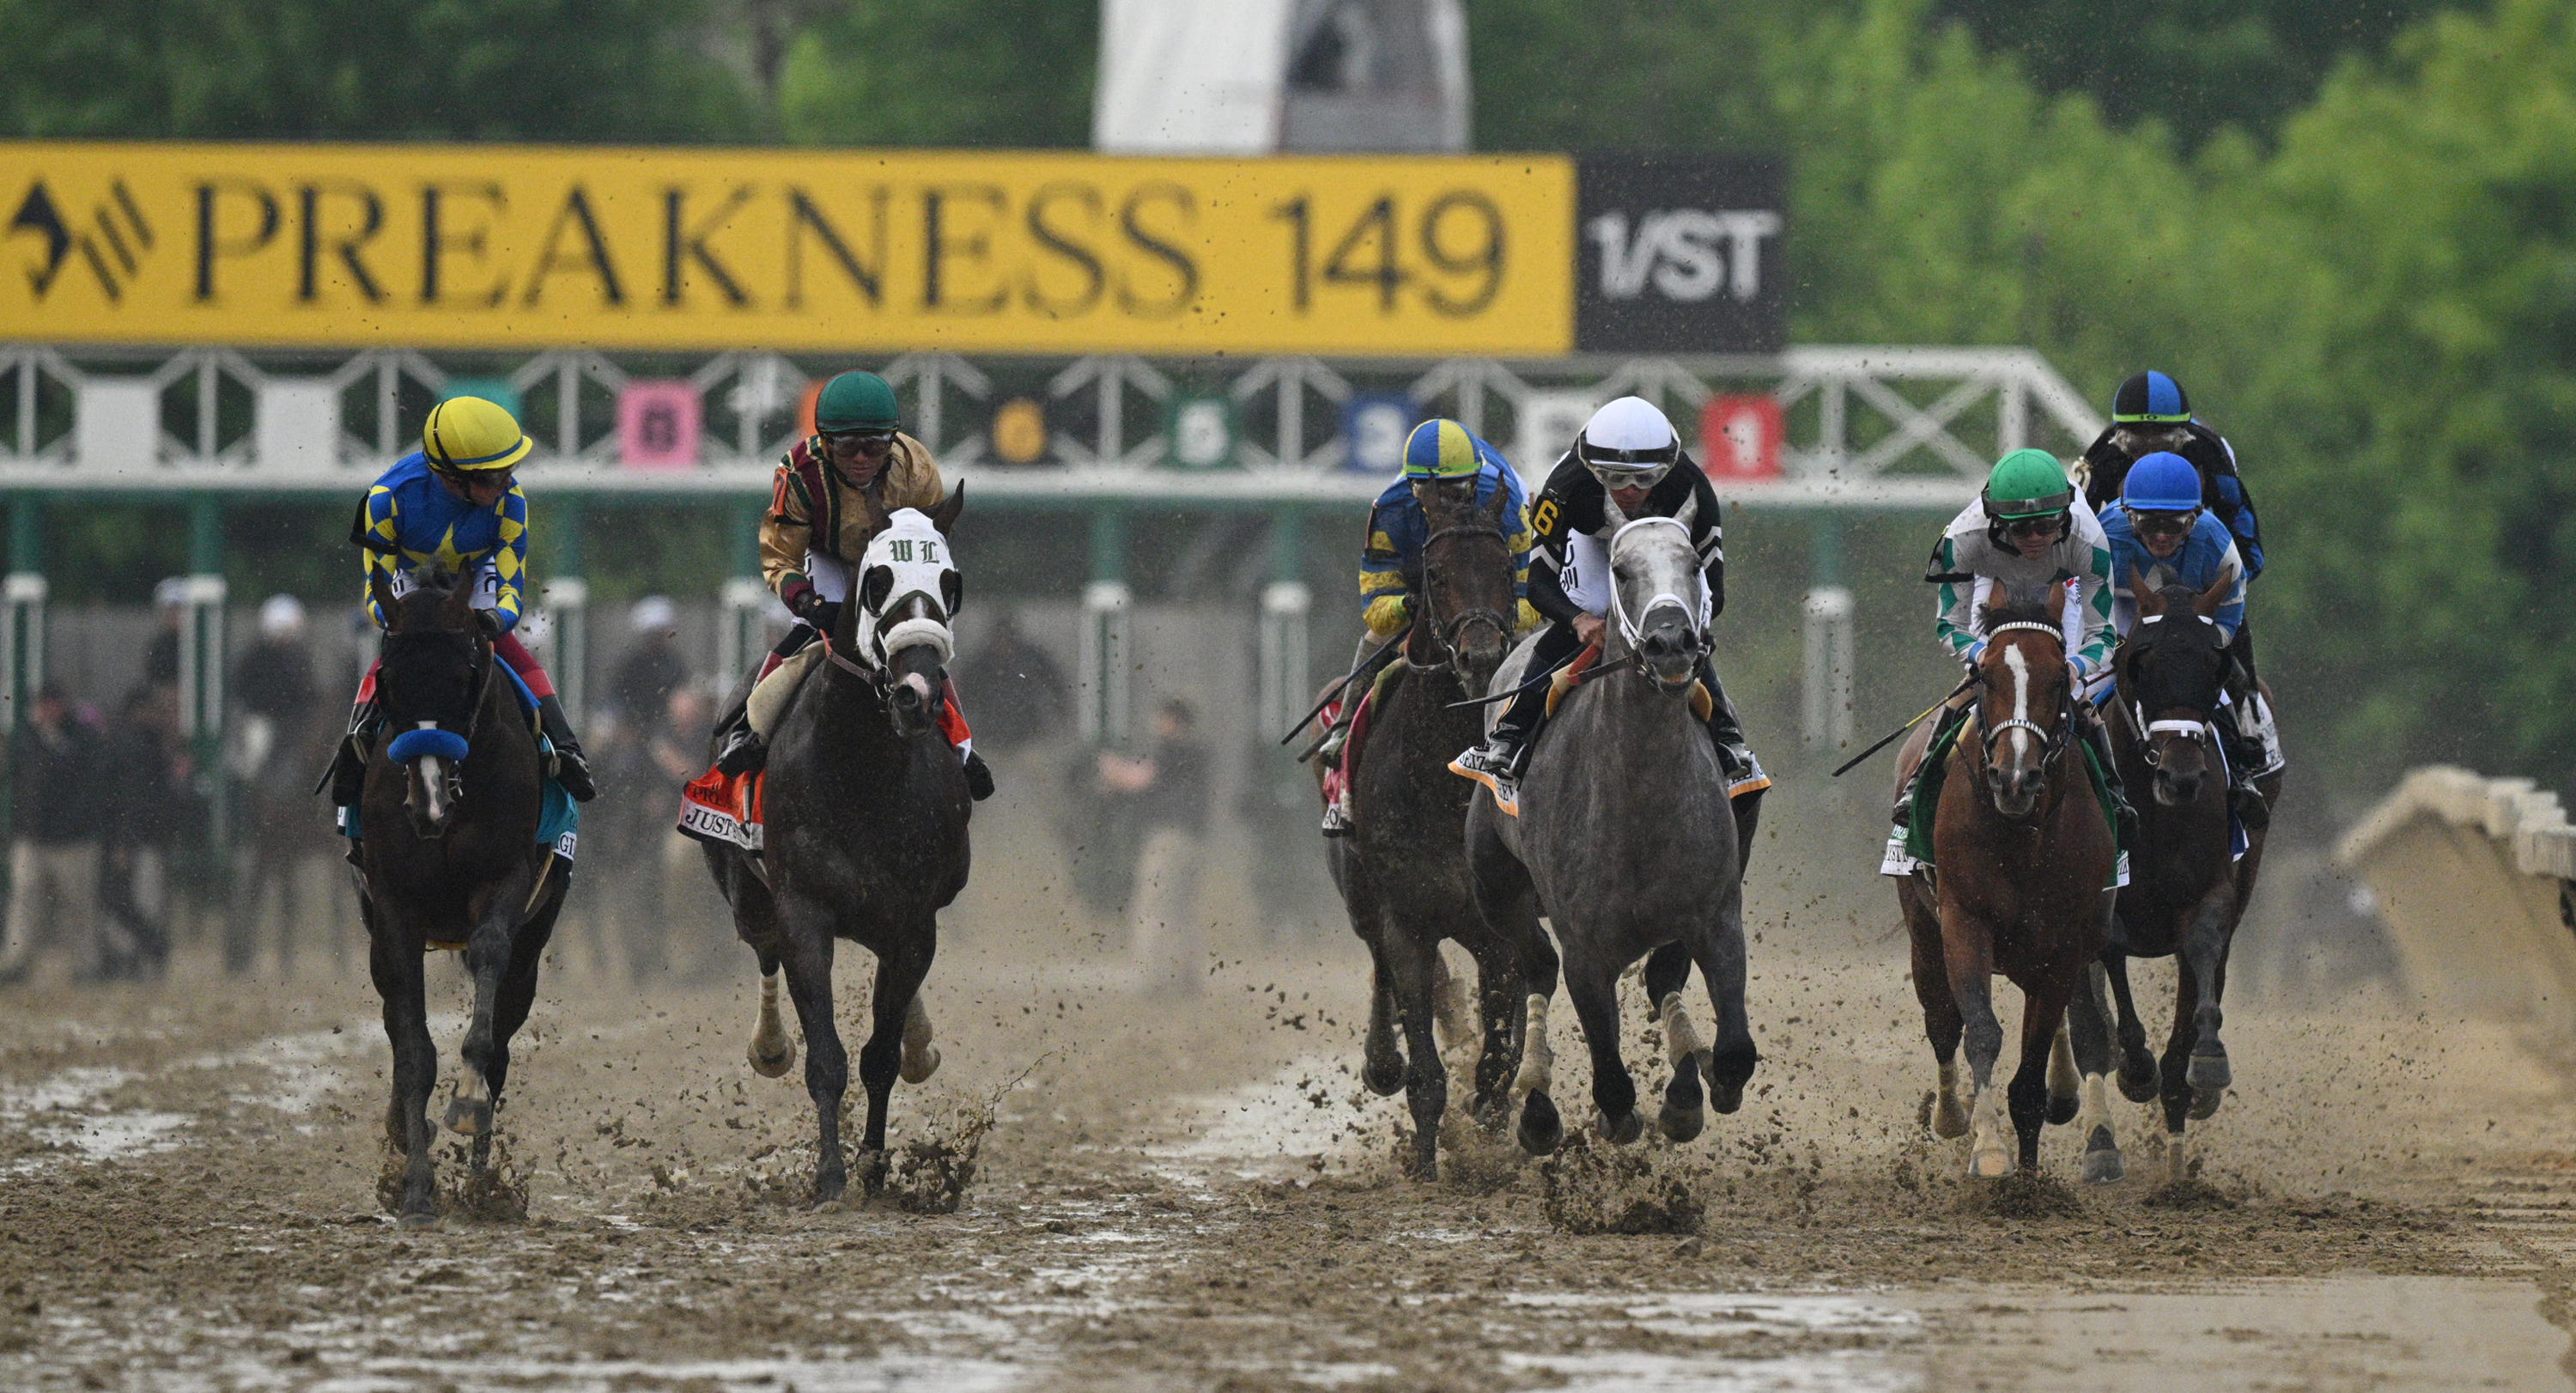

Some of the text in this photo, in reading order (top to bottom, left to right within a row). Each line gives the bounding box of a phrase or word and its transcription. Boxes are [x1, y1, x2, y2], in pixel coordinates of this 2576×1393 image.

[192, 179, 1510, 319] PREAKNESS 149
[1586, 206, 1785, 304] 1/ST
[1726, 411, 1761, 471] 1
[1534, 500, 1558, 536] 6
[685, 808, 732, 836] JUST
